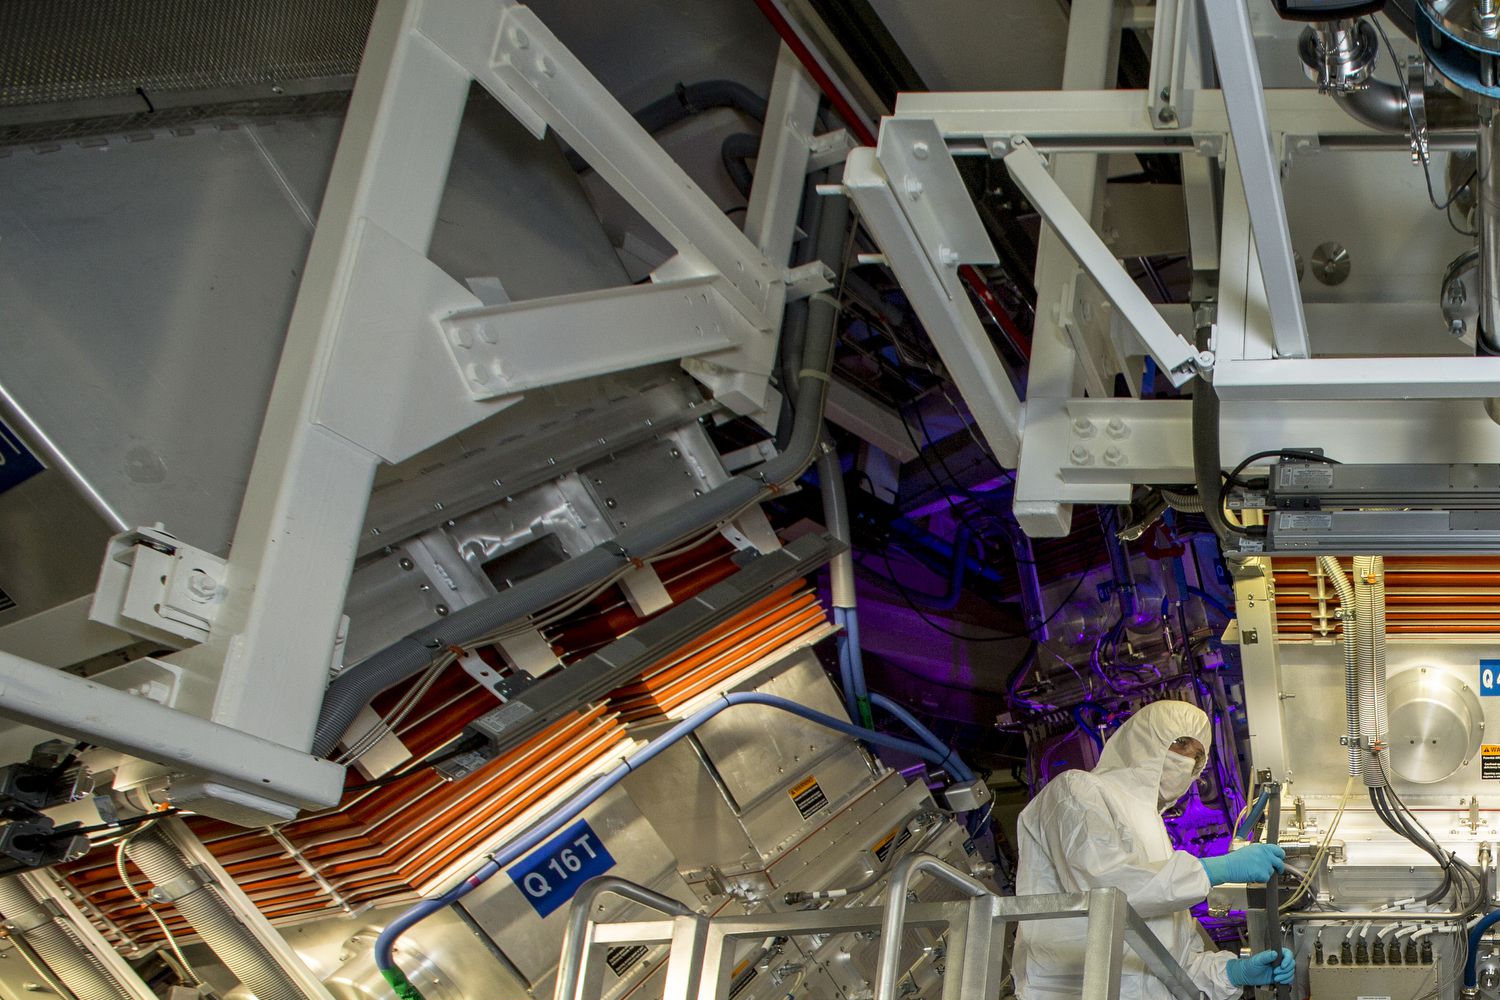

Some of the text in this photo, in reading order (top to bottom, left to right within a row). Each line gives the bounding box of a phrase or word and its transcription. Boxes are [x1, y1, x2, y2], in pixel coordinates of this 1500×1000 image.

[1482, 669, 1493, 688] Q
[523, 834, 598, 898] Q 16 T
